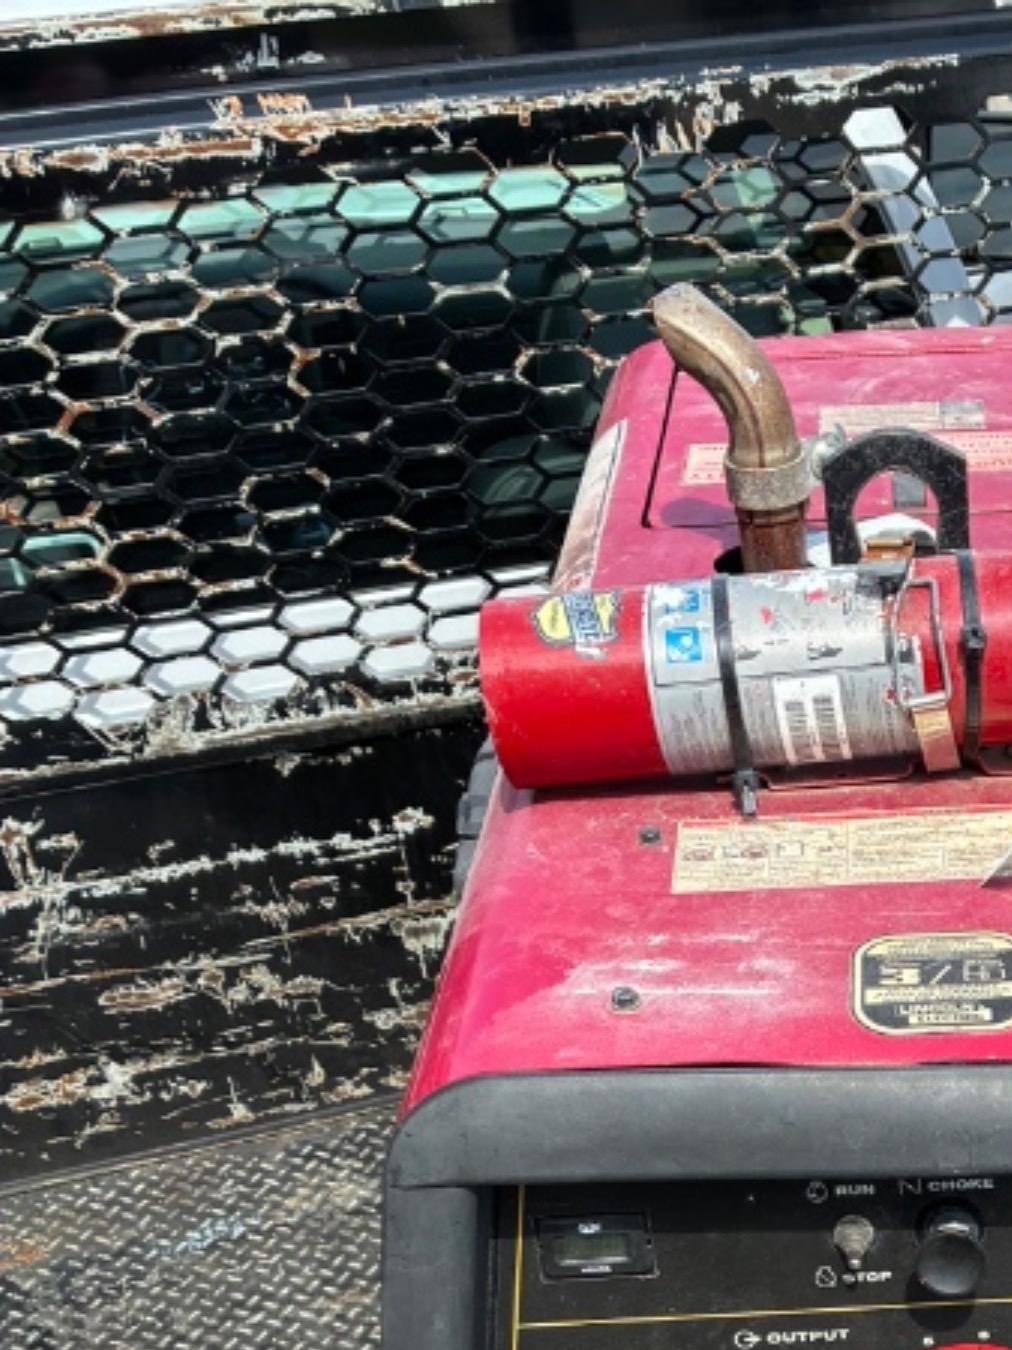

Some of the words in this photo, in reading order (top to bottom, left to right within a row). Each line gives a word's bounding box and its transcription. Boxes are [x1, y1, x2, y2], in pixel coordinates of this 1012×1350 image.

[834, 1184, 875, 1195] RUN
[927, 1178, 994, 1192] CHOKE
[767, 1328, 850, 1344] OUTPUT
